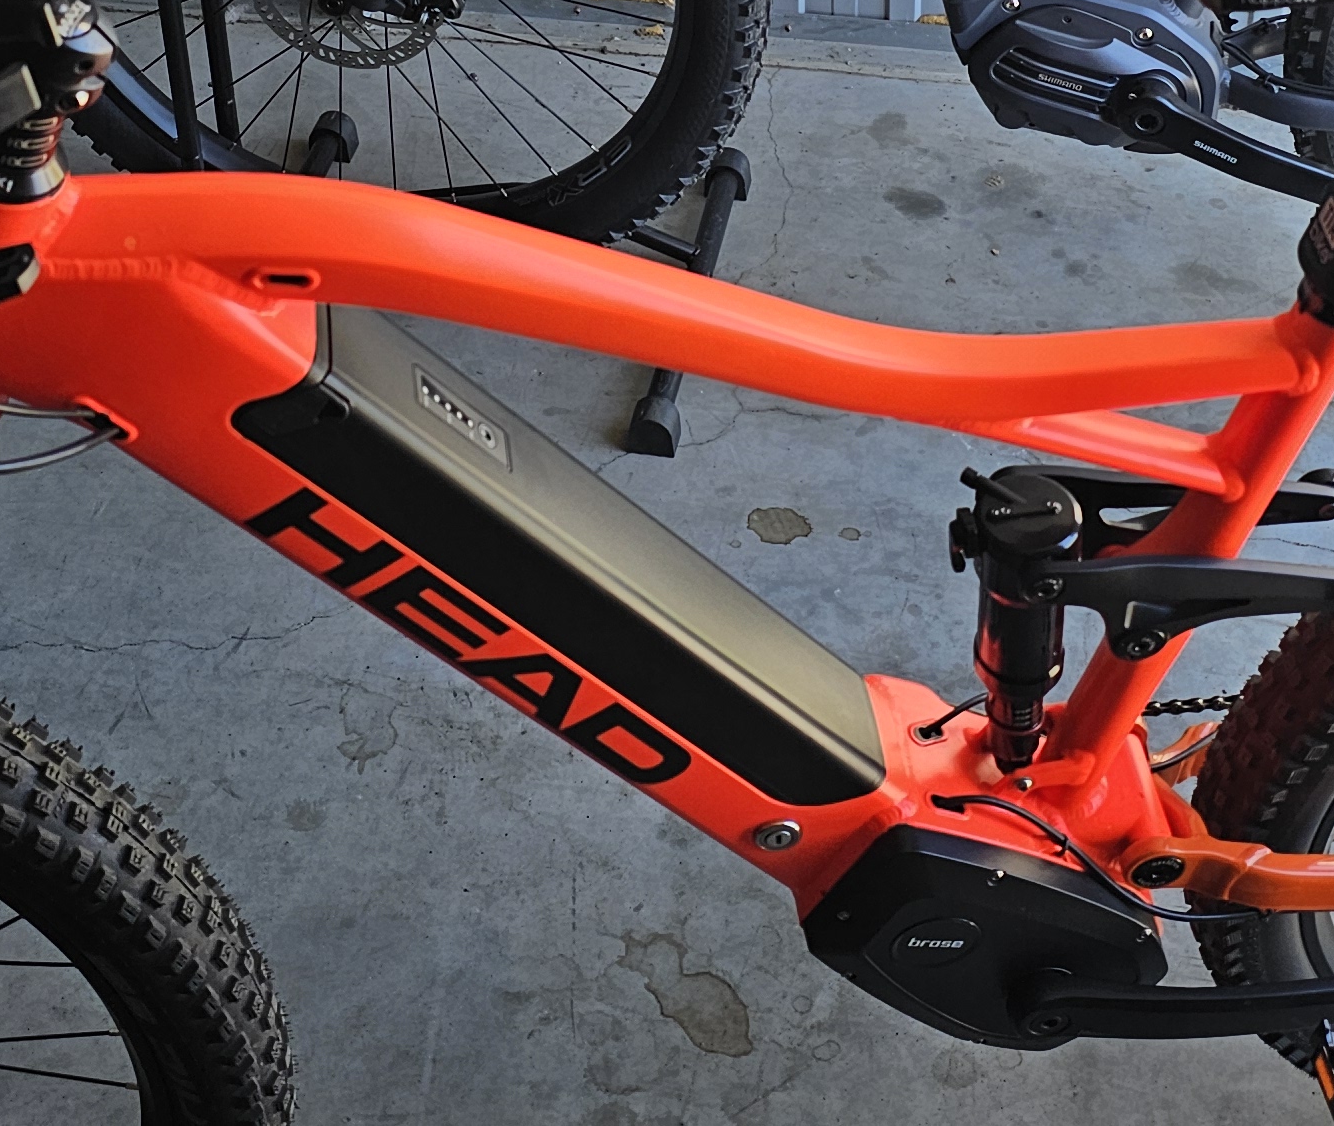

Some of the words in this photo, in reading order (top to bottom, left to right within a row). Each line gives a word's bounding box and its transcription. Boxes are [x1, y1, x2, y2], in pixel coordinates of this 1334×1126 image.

[1038, 73, 1083, 92] SHIMANO
[1193, 139, 1238, 164] SHIMANO
[246, 487, 692, 785] HEAD
[907, 937, 964, 949] brose
